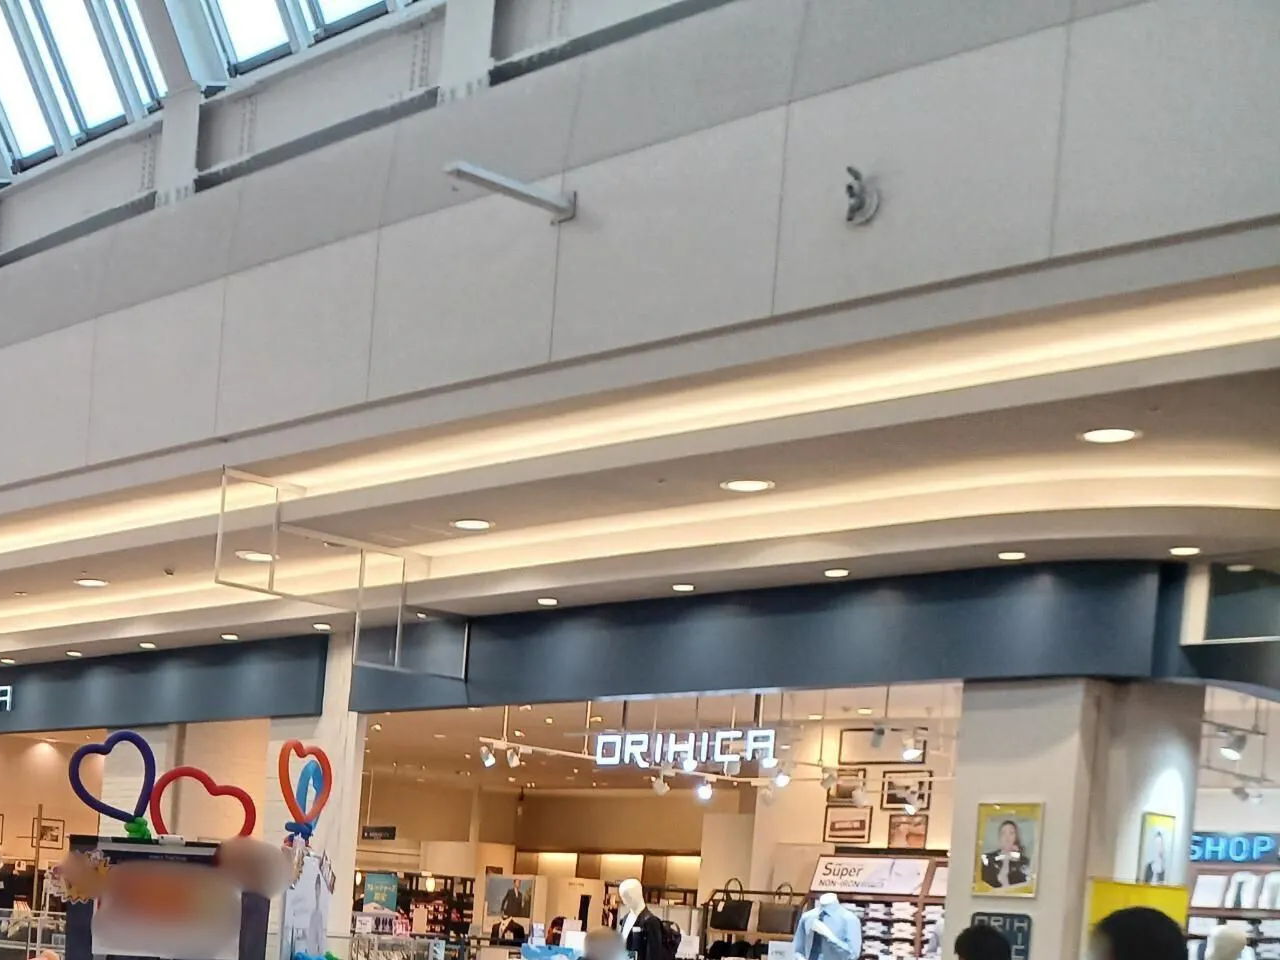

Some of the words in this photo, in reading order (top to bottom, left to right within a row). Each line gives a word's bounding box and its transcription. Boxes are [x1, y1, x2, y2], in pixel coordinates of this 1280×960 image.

[596, 729, 776, 769] ORIHICA
[1190, 835, 1276, 861] SHOP
[822, 862, 864, 880] Super
